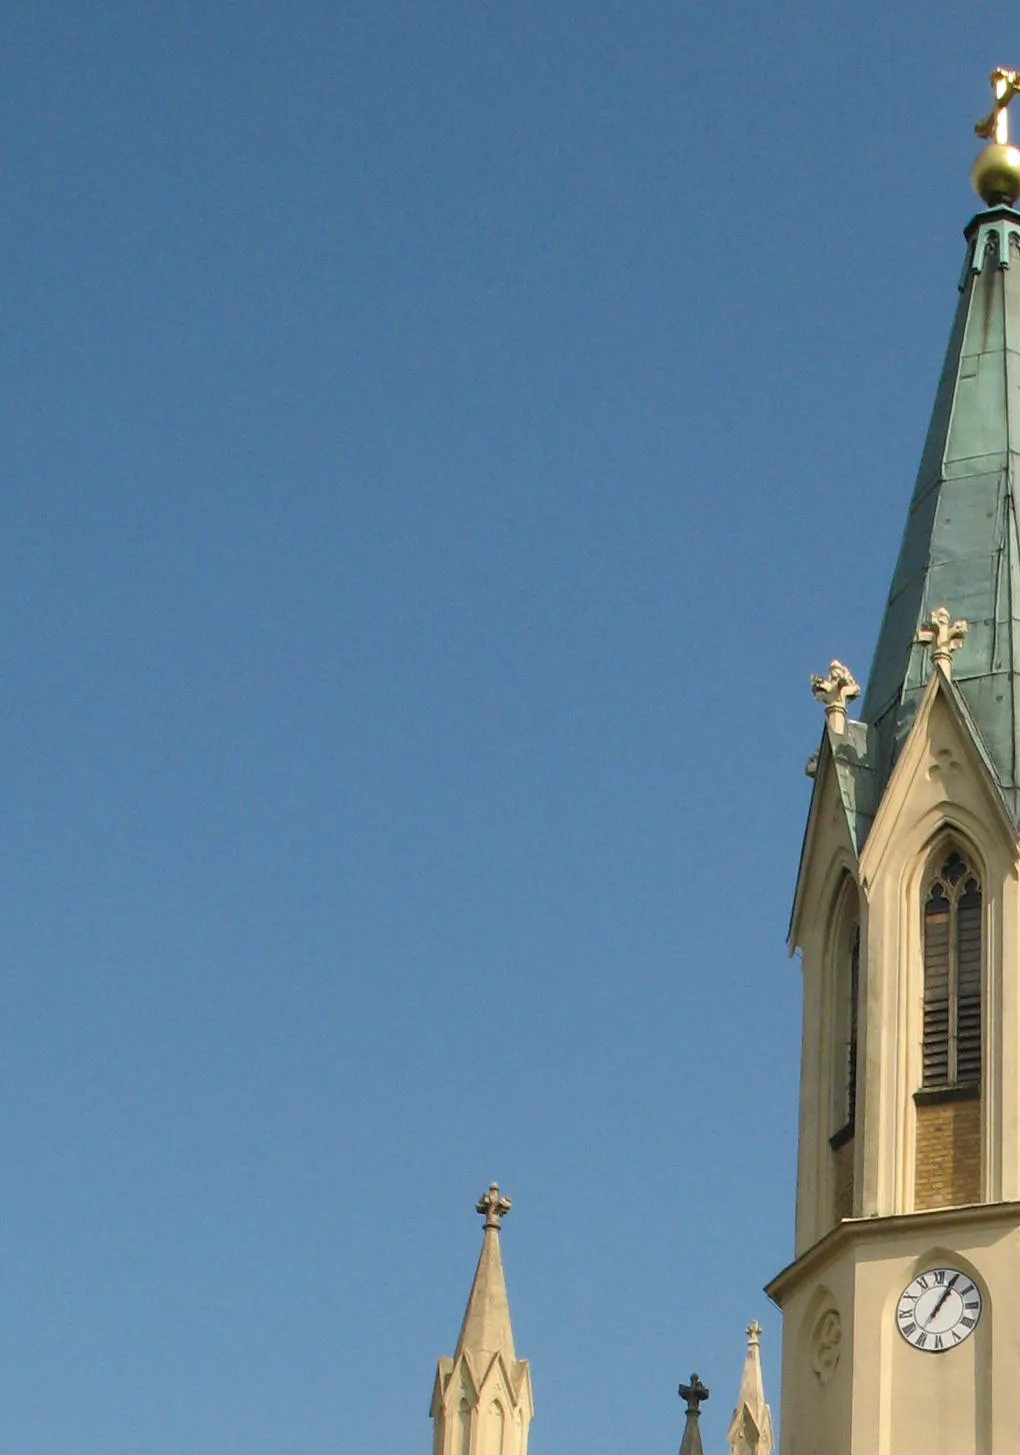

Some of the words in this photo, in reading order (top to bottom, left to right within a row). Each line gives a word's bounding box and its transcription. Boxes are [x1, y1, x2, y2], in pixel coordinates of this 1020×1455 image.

[916, 1276, 929, 1290] XI
[933, 1271, 945, 1284] XII
[903, 1291, 918, 1302] X
[899, 1309, 913, 1319] IX
[934, 1335, 943, 1348] VI
[951, 1330, 961, 1342] V
